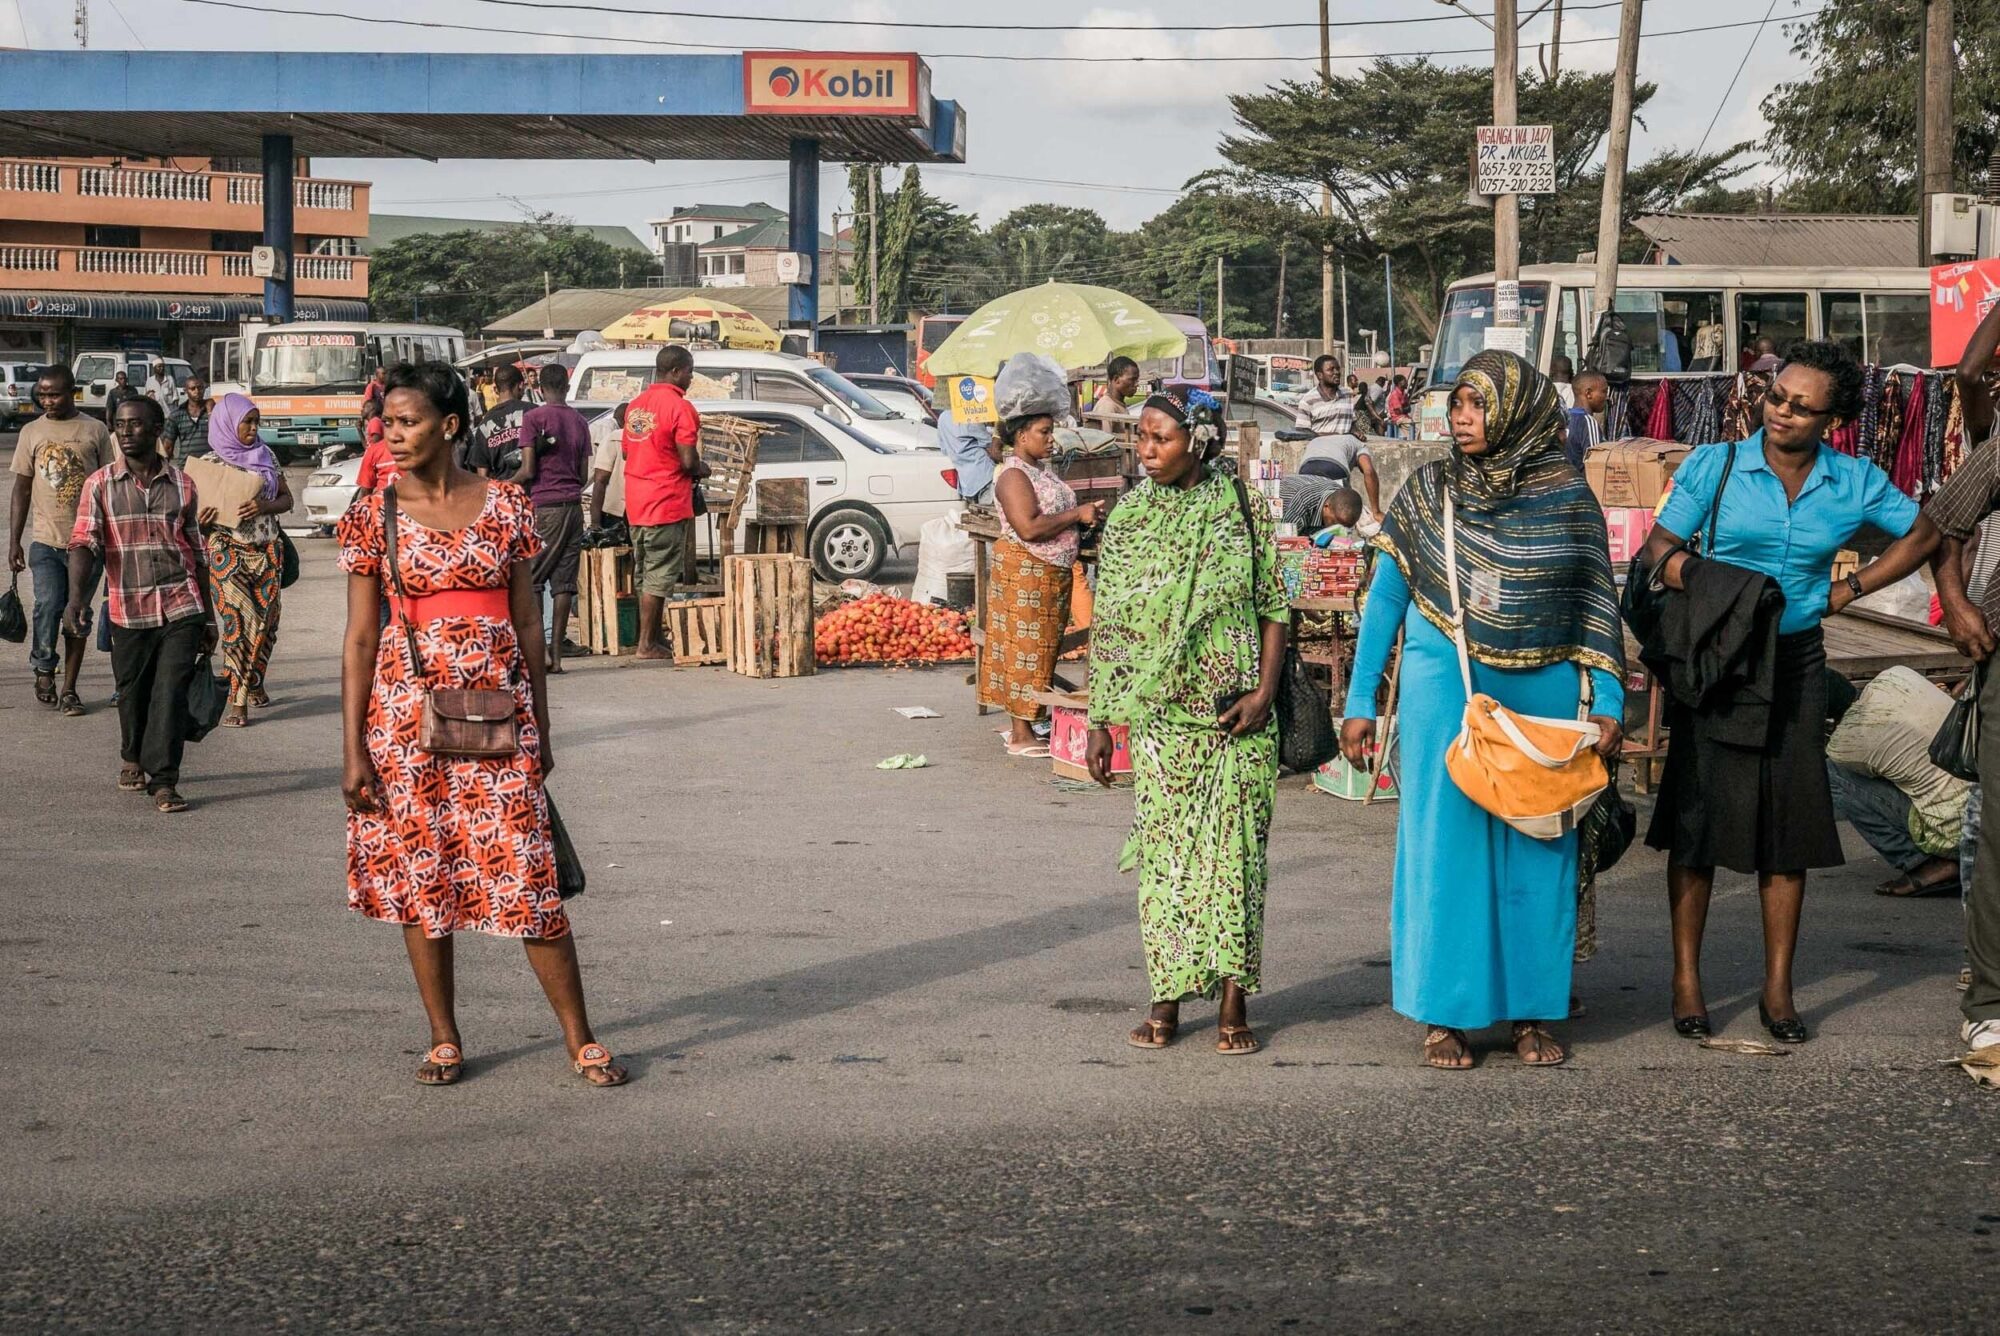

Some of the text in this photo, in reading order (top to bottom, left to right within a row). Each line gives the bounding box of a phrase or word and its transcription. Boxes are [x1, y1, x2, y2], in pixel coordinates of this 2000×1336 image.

[803, 68, 893, 98] Kobil
[1477, 128, 1552, 145] MGANGA WA JADI
[1507, 145, 1547, 160] NKUBA
[47, 301, 76, 313] pepsi
[266, 335, 356, 346] ALLAH KARIM
[963, 404, 988, 415] Wakala
